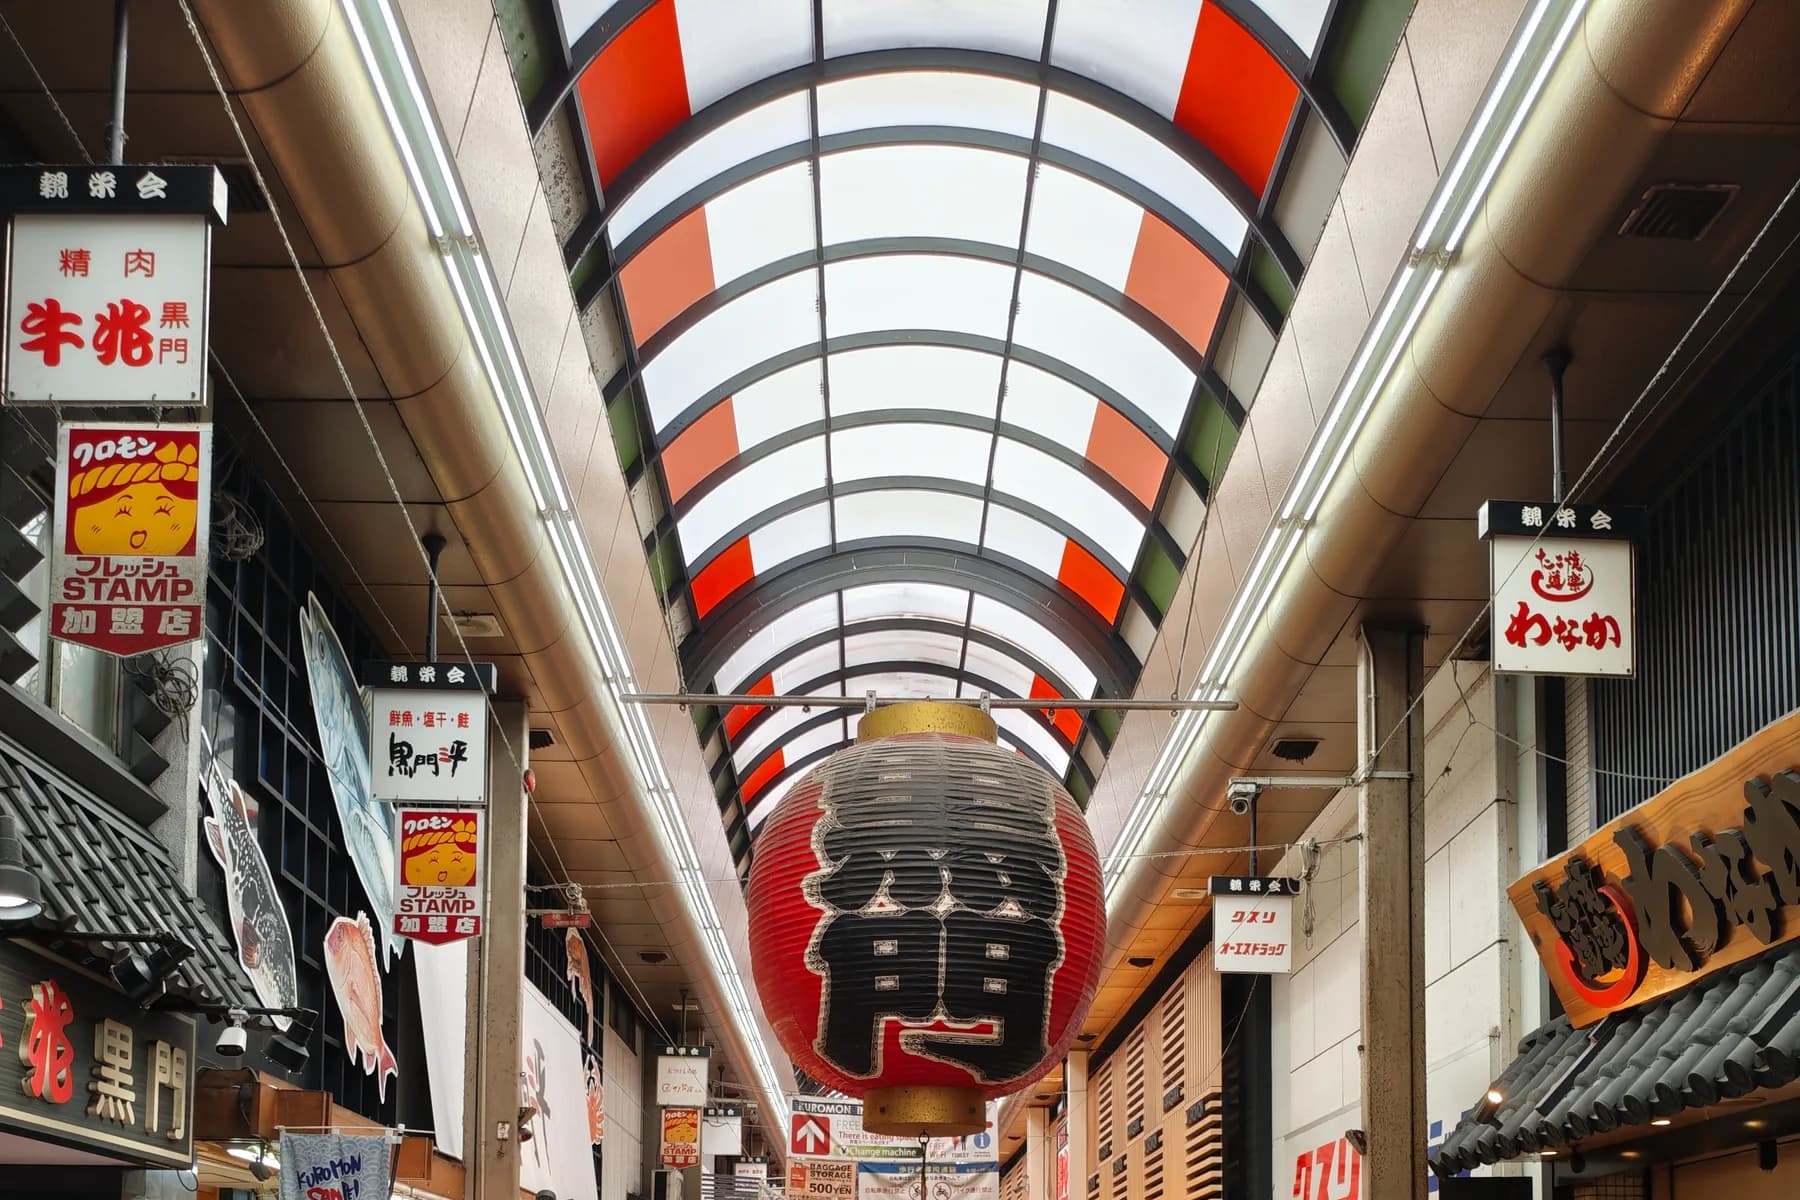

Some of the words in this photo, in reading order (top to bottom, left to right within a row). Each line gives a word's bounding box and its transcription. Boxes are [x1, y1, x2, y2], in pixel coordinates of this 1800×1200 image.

[59, 249, 155, 278] 精肉
[20, 298, 154, 367] 牛兆
[159, 302, 189, 364] 黒門
[73, 436, 157, 467] クロモン
[75, 557, 180, 578] フレッシュ
[63, 577, 194, 602] STAMP
[61, 607, 193, 635] 加盟店
[1505, 600, 1622, 652] わなか
[404, 815, 453, 835] クロモン
[407, 886, 467, 899] フレッシュ
[400, 899, 476, 914] STAMP
[803, 742, 1068, 1083] 黒門
[400, 917, 476, 934] 加盟店
[1231, 911, 1276, 924] クスリ
[86, 1017, 188, 1142] 黒門
[798, 1102, 852, 1114] KUROMON
[837, 1120, 861, 1131] FREE
[838, 1131, 862, 1139] There
[863, 1131, 870, 1140] is
[849, 1147, 880, 1158] Change
[884, 1147, 917, 1157] machine
[296, 1151, 362, 1190] KUROMON
[809, 1163, 853, 1172] BAGGAGE
[809, 1171, 853, 1179] STORAGE
[809, 1183, 833, 1194] 500
